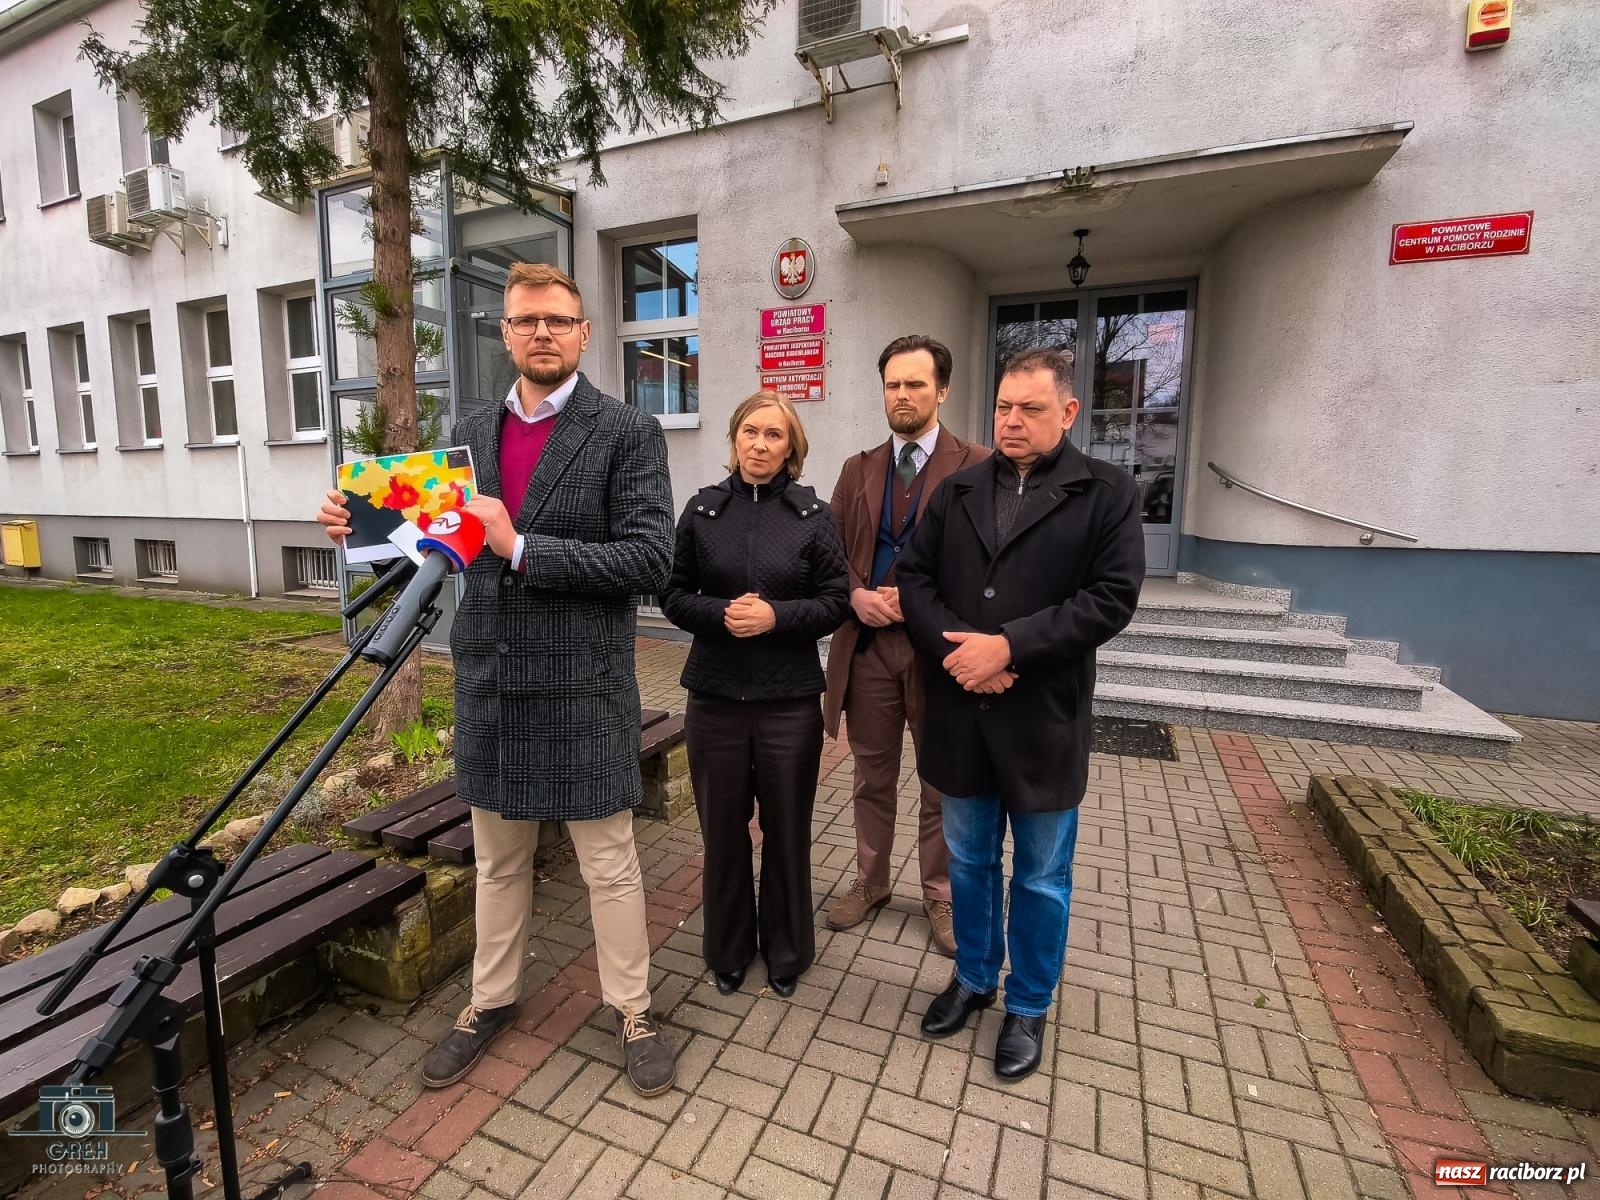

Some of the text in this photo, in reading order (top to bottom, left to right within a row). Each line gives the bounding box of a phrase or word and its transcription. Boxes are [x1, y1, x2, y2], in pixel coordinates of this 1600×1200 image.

[1431, 222, 1491, 234] POWIATOWE
[1399, 228, 1526, 247] CENTRUM POMOCY RODZINIE
[1436, 240, 1495, 253] RACIBORZU
[773, 307, 812, 318] POWIATOWY
[770, 315, 815, 327] URZĄD PRACY
[782, 326, 810, 334] Raciborzu
[763, 373, 822, 384] CENTRUM AKTYWIZACJI
[777, 383, 808, 392] ZAWODOWEJ
